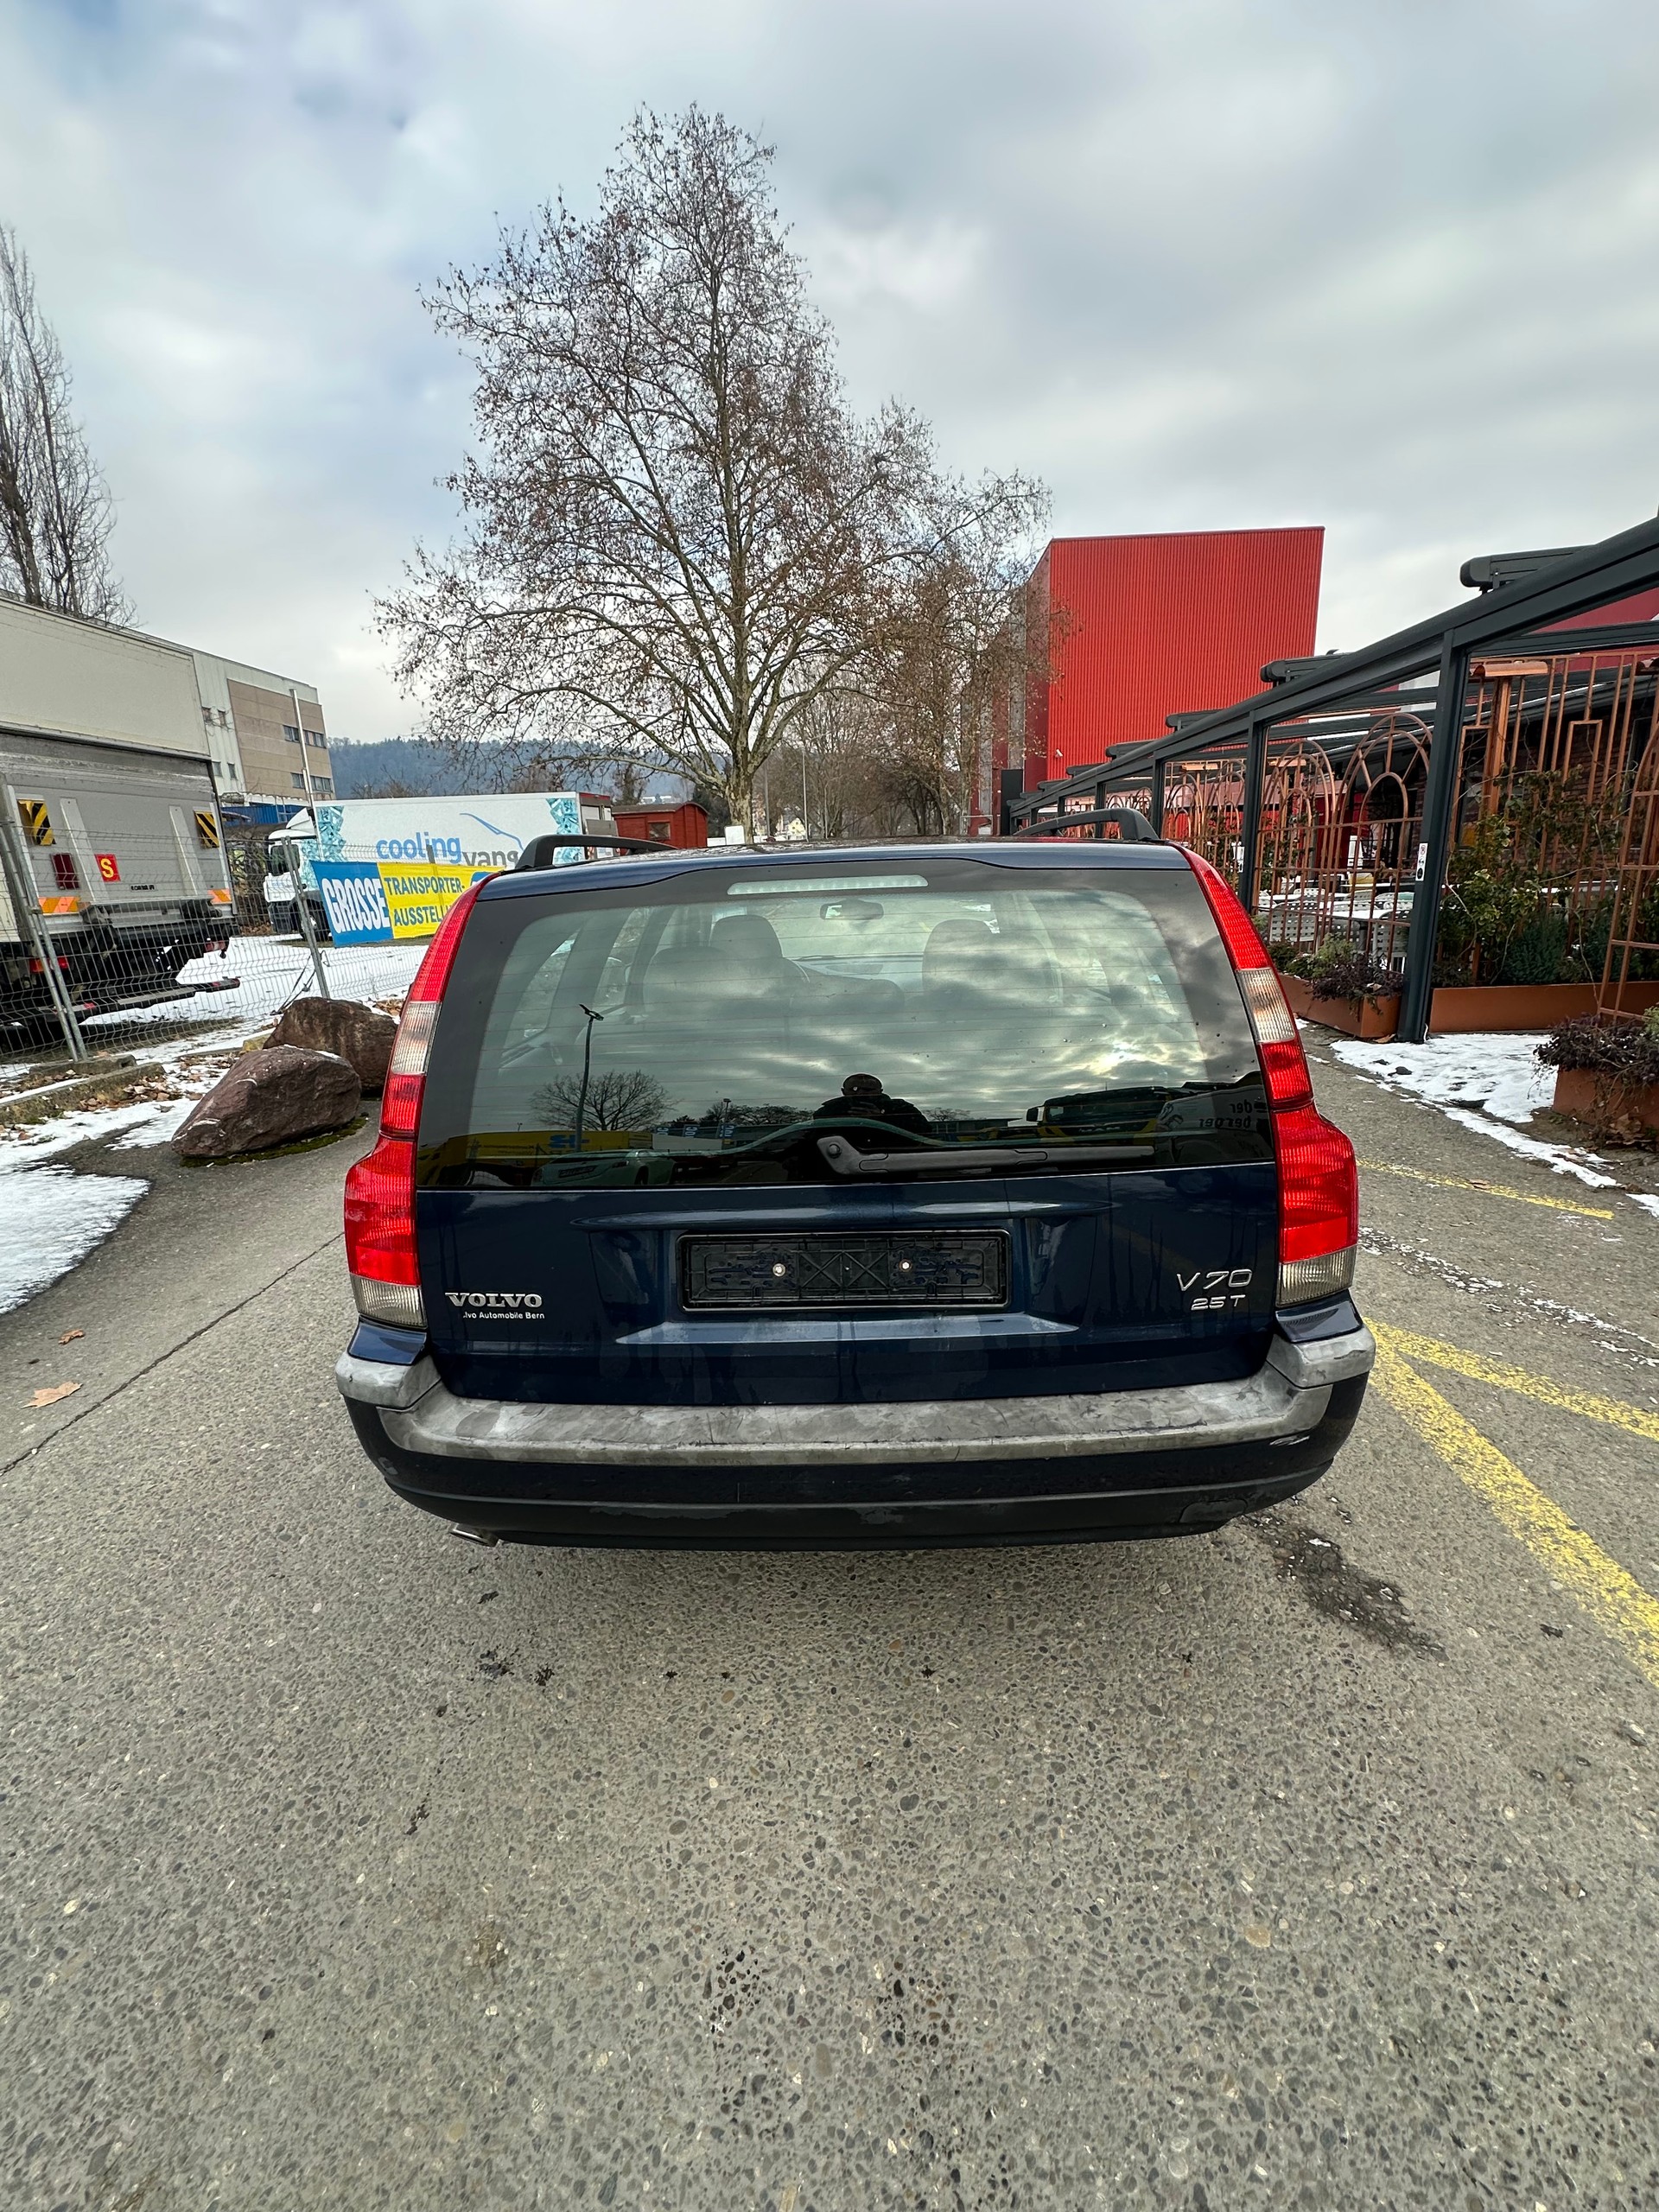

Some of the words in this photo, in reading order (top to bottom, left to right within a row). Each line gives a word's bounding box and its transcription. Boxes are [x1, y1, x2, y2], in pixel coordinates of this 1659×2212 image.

[376, 831, 461, 864] cooling
[99, 858, 114, 879] S
[384, 874, 466, 896] TRANSPORTER-
[321, 876, 391, 935] GROSSE
[444, 1292, 543, 1308] VOLVO
[479, 1311, 524, 1319] Automobile
